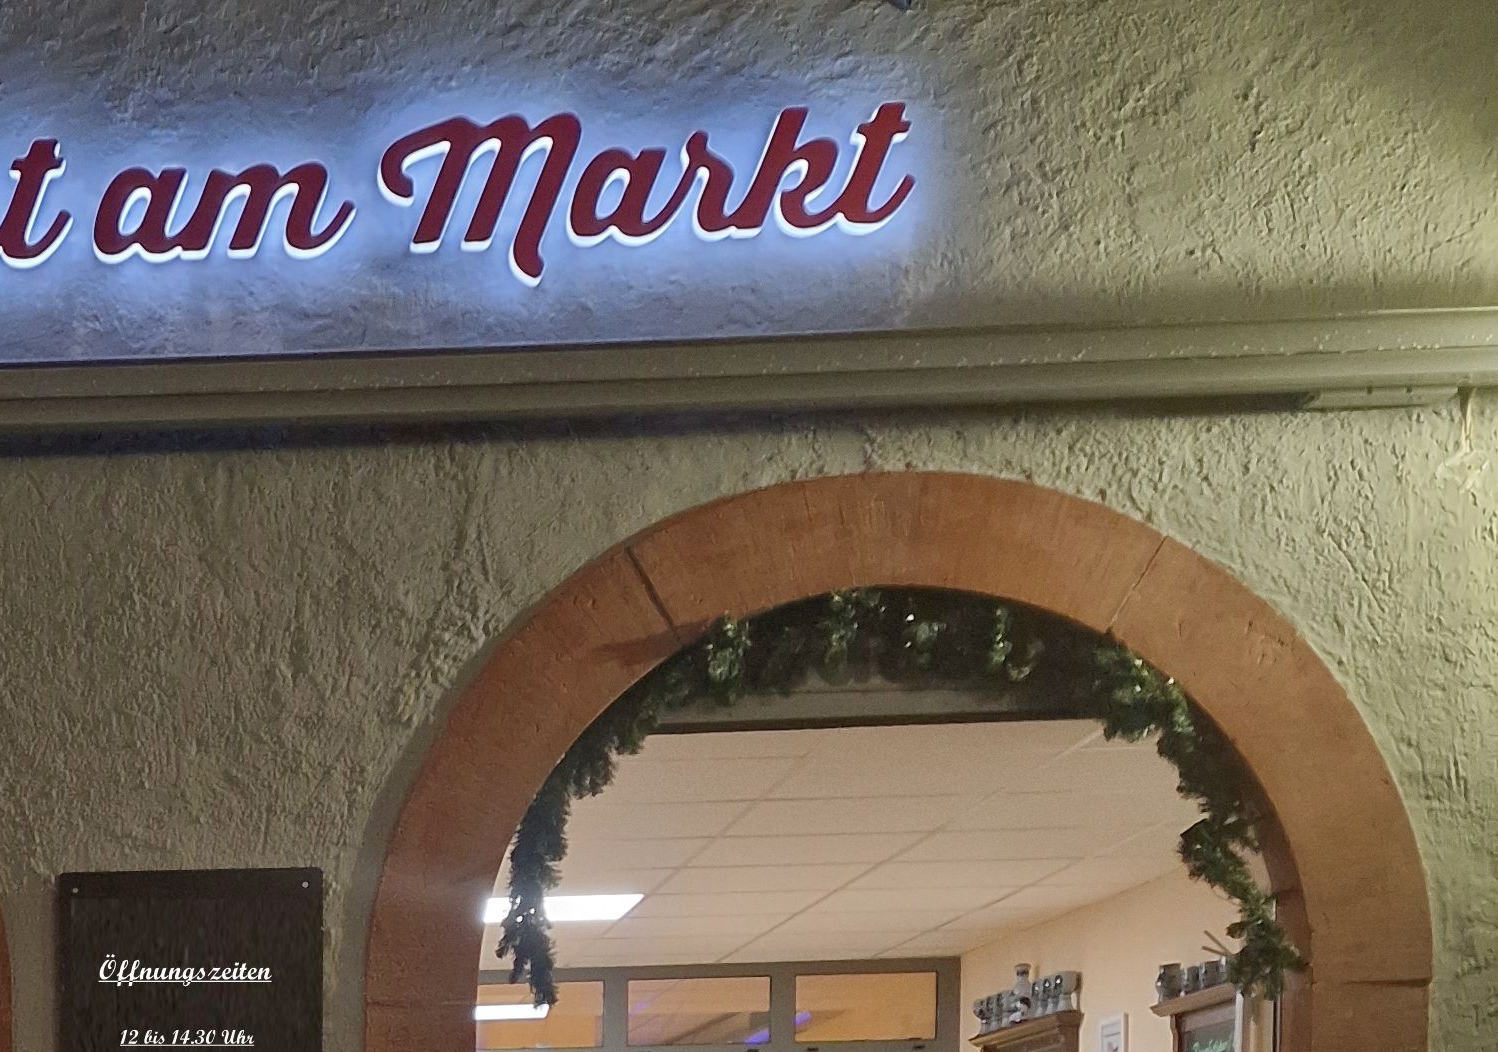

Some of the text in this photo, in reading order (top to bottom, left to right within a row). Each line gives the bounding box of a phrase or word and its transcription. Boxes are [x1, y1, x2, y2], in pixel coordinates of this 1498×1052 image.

[92, 162, 357, 262] am
[377, 102, 916, 287] Markt
[98, 954, 273, 987] Öffnungszeiten
[120, 1029, 255, 1046] 12 bis 14.30 Uhr
